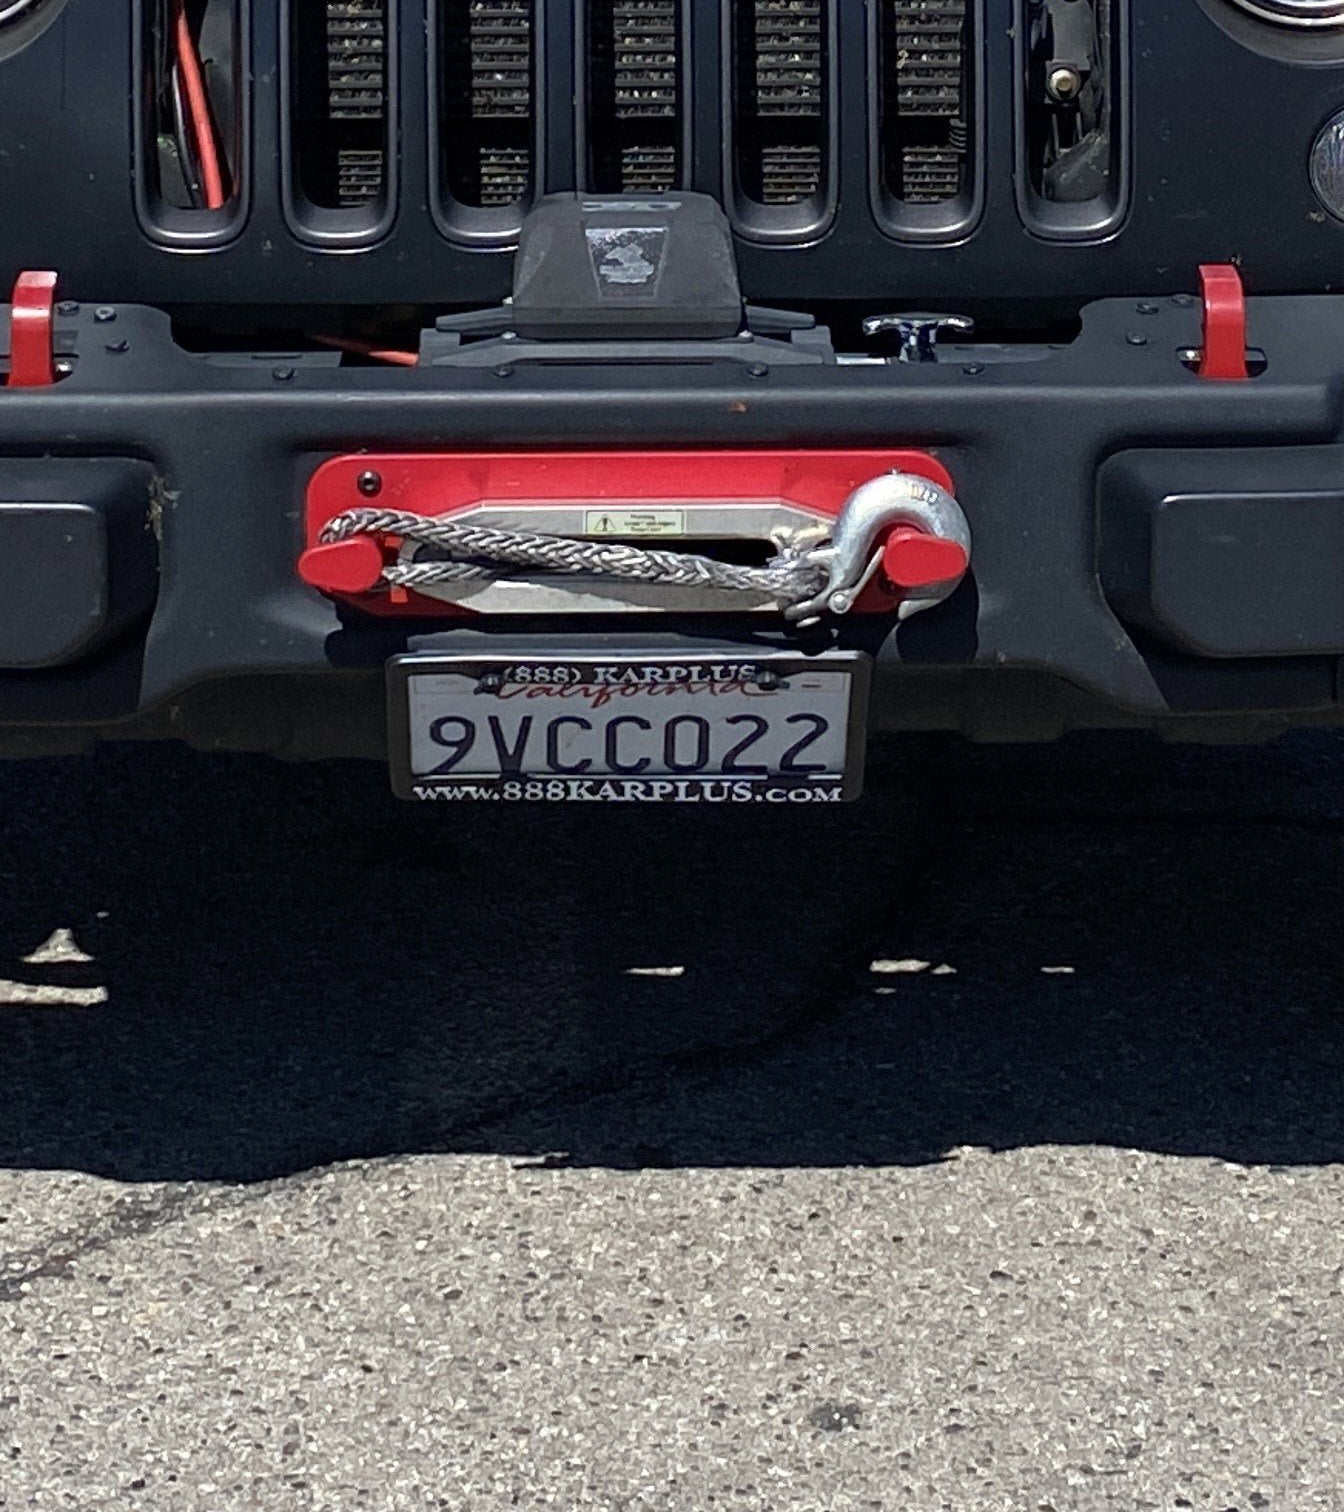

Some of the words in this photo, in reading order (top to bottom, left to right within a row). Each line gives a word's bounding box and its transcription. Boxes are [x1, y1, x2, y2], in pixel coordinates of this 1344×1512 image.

[503, 665, 582, 684] (888)
[593, 664, 757, 685] KARPLUS
[429, 713, 829, 775] 9VCC022
